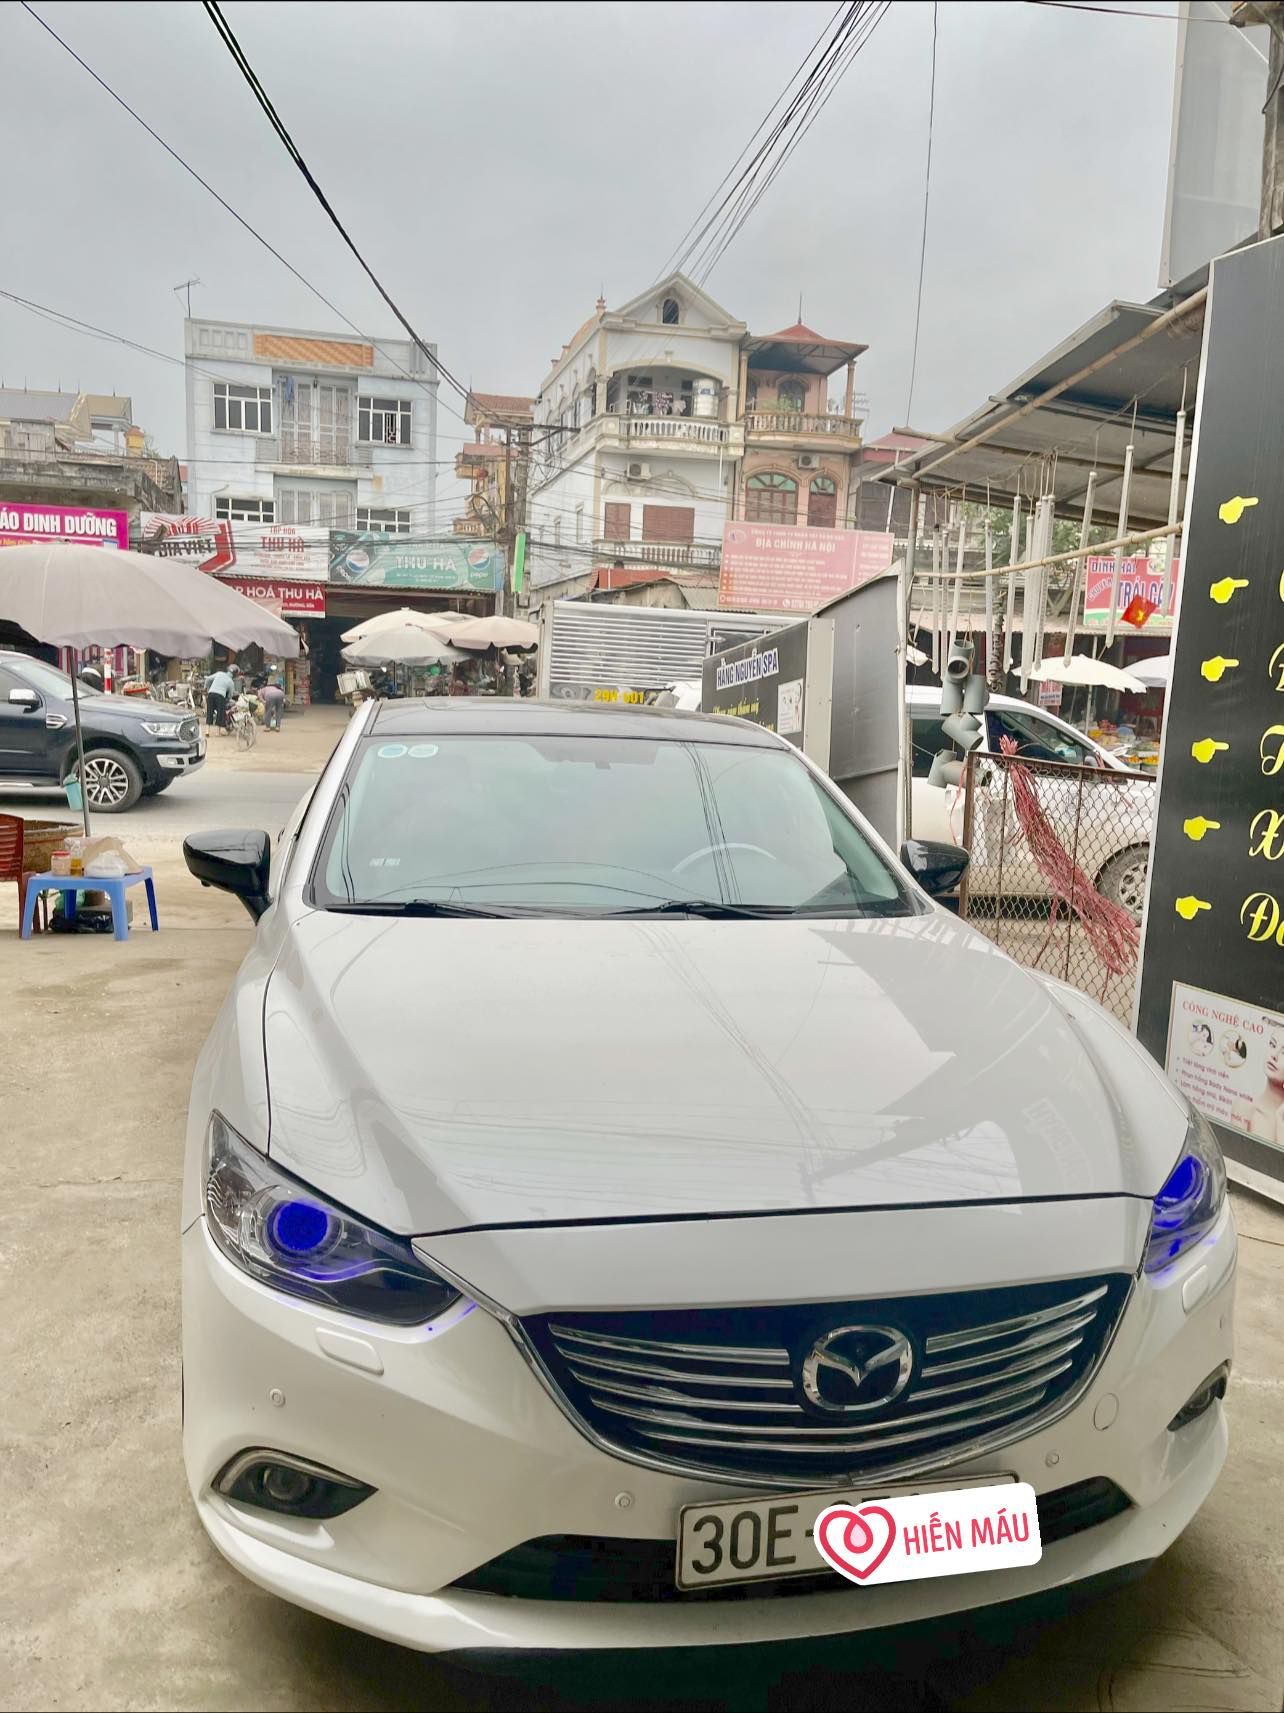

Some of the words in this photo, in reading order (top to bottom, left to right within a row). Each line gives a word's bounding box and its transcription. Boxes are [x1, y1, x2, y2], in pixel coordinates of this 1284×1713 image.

[23, 512, 60, 533] DINH
[64, 511, 117, 537] DƯỠNG
[278, 587, 302, 599] THU
[306, 586, 324, 600] HÀ
[763, 651, 778, 674] SPA
[1182, 1000, 1210, 1018] CÔNG
[1211, 1009, 1240, 1028] NGHỆ
[1242, 1018, 1264, 1036] CAO
